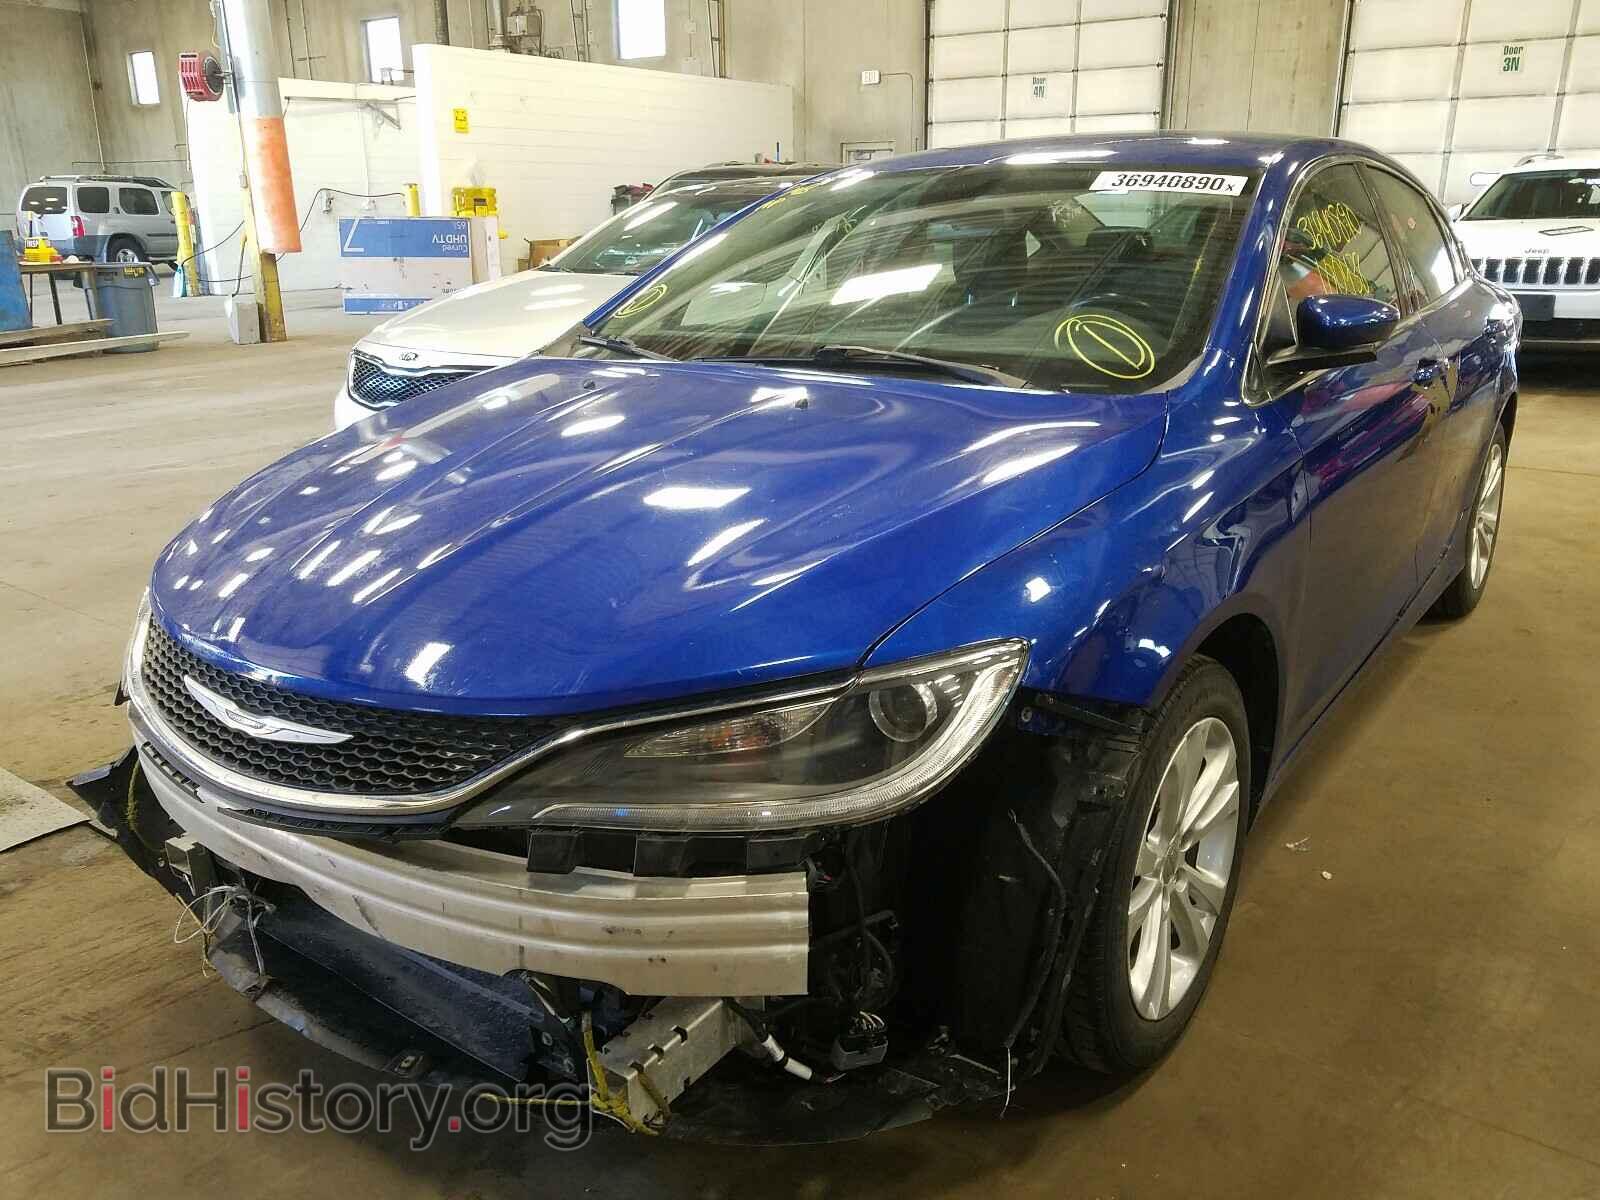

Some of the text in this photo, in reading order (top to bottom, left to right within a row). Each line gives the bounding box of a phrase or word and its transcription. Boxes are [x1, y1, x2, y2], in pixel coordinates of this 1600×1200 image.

[1503, 45, 1524, 55] Door
[1503, 57, 1520, 72] 3N
[1033, 86, 1045, 98] 4N
[1111, 174, 1226, 190] 36940890
[343, 217, 365, 252] 7
[442, 244, 468, 252] Curved
